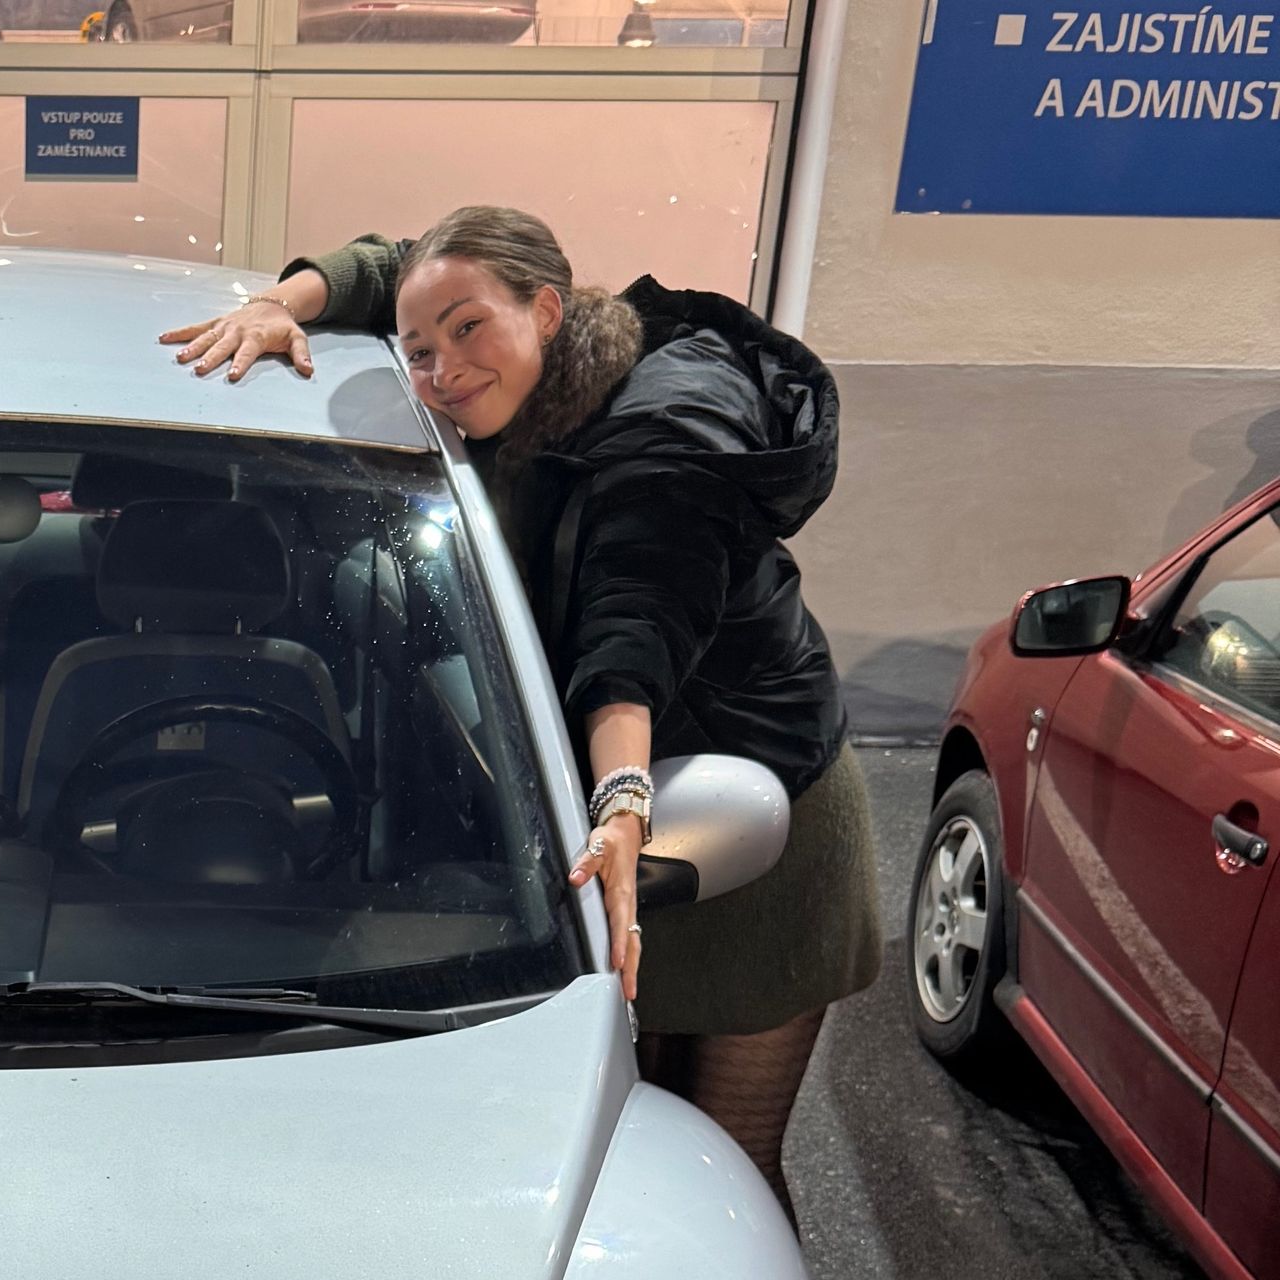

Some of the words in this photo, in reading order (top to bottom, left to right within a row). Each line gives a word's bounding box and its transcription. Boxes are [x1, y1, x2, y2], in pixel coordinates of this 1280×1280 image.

[1045, 5, 1274, 54] ZAJISTÍME
[1034, 78, 1064, 117] A
[40, 112, 80, 123] VSTUP
[82, 112, 124, 124] POUZE
[69, 128, 95, 140] PRO
